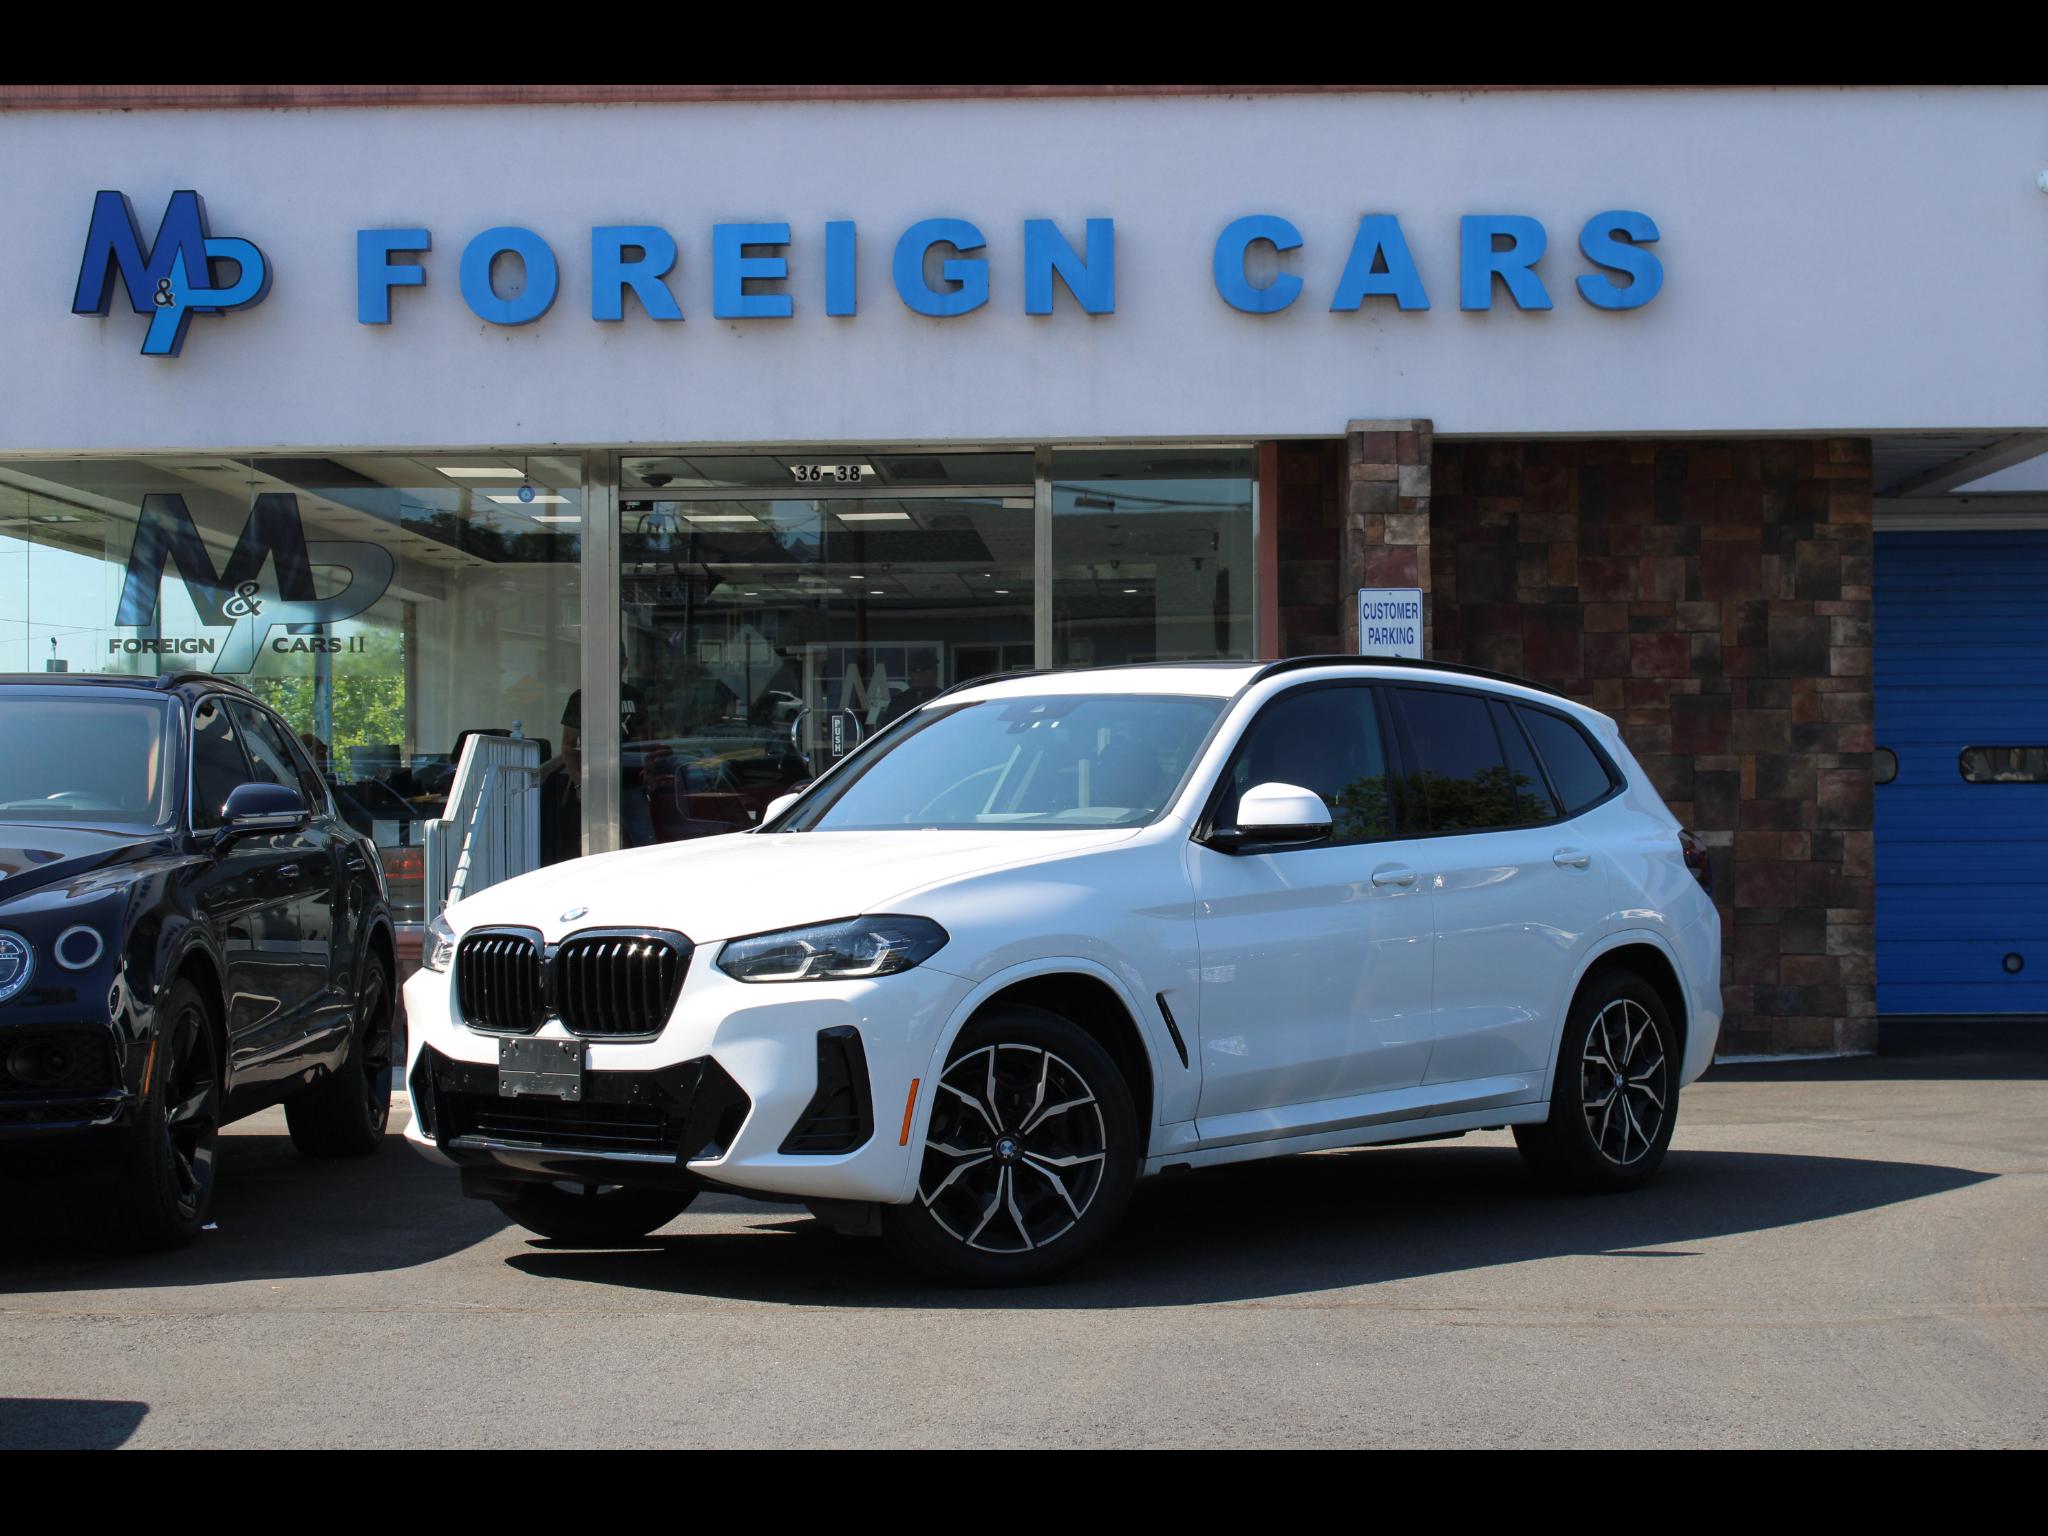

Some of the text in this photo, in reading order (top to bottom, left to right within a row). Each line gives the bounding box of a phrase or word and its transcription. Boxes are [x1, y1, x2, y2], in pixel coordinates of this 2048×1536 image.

[357, 217, 1116, 325] FOREIGN
[1212, 209, 1665, 314] CARS
[797, 465, 861, 481] 36-38
[1362, 602, 1419, 620] CUSTOMER
[1368, 626, 1415, 645] PARKING
[108, 637, 215, 655] FOREIGN
[271, 636, 342, 654] CARS
